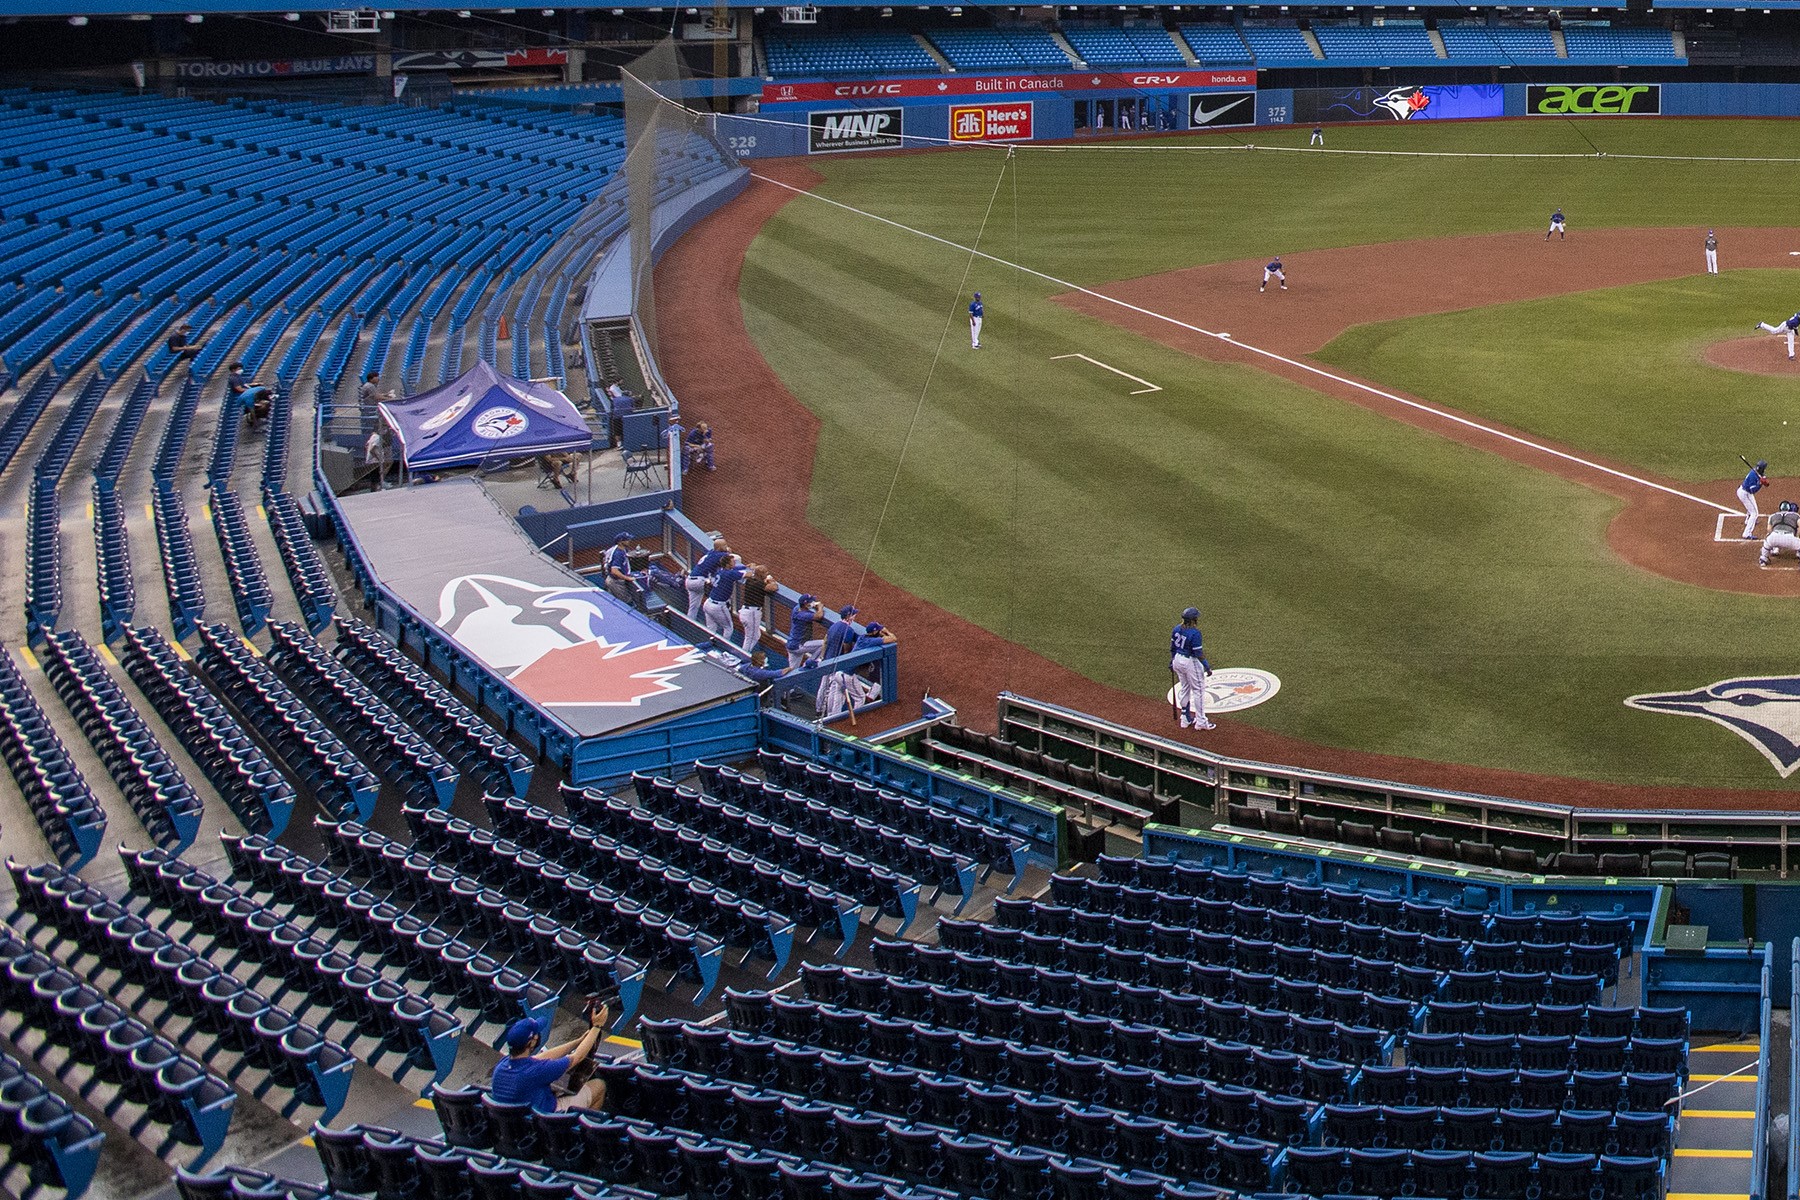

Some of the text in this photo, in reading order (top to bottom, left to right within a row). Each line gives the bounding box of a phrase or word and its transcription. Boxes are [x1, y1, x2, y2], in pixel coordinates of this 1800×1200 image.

[177, 55, 374, 77] TORONTO BLUE JAYS
[975, 77, 1064, 92] Built in Canada
[1133, 75, 1180, 86] CR-V
[1211, 74, 1247, 83] honda.ca
[835, 84, 901, 96] CIVIC
[1538, 85, 1649, 113] acer
[987, 109, 1027, 122] Here's
[1268, 107, 1286, 117] 375
[823, 113, 890, 140] MNP
[987, 123, 1019, 135] How.
[729, 136, 757, 148] 328
[815, 140, 844, 148] Wherever
[845, 139, 869, 147] Business
[870, 138, 885, 146] Takes
[1174, 632, 1187, 649] 27
